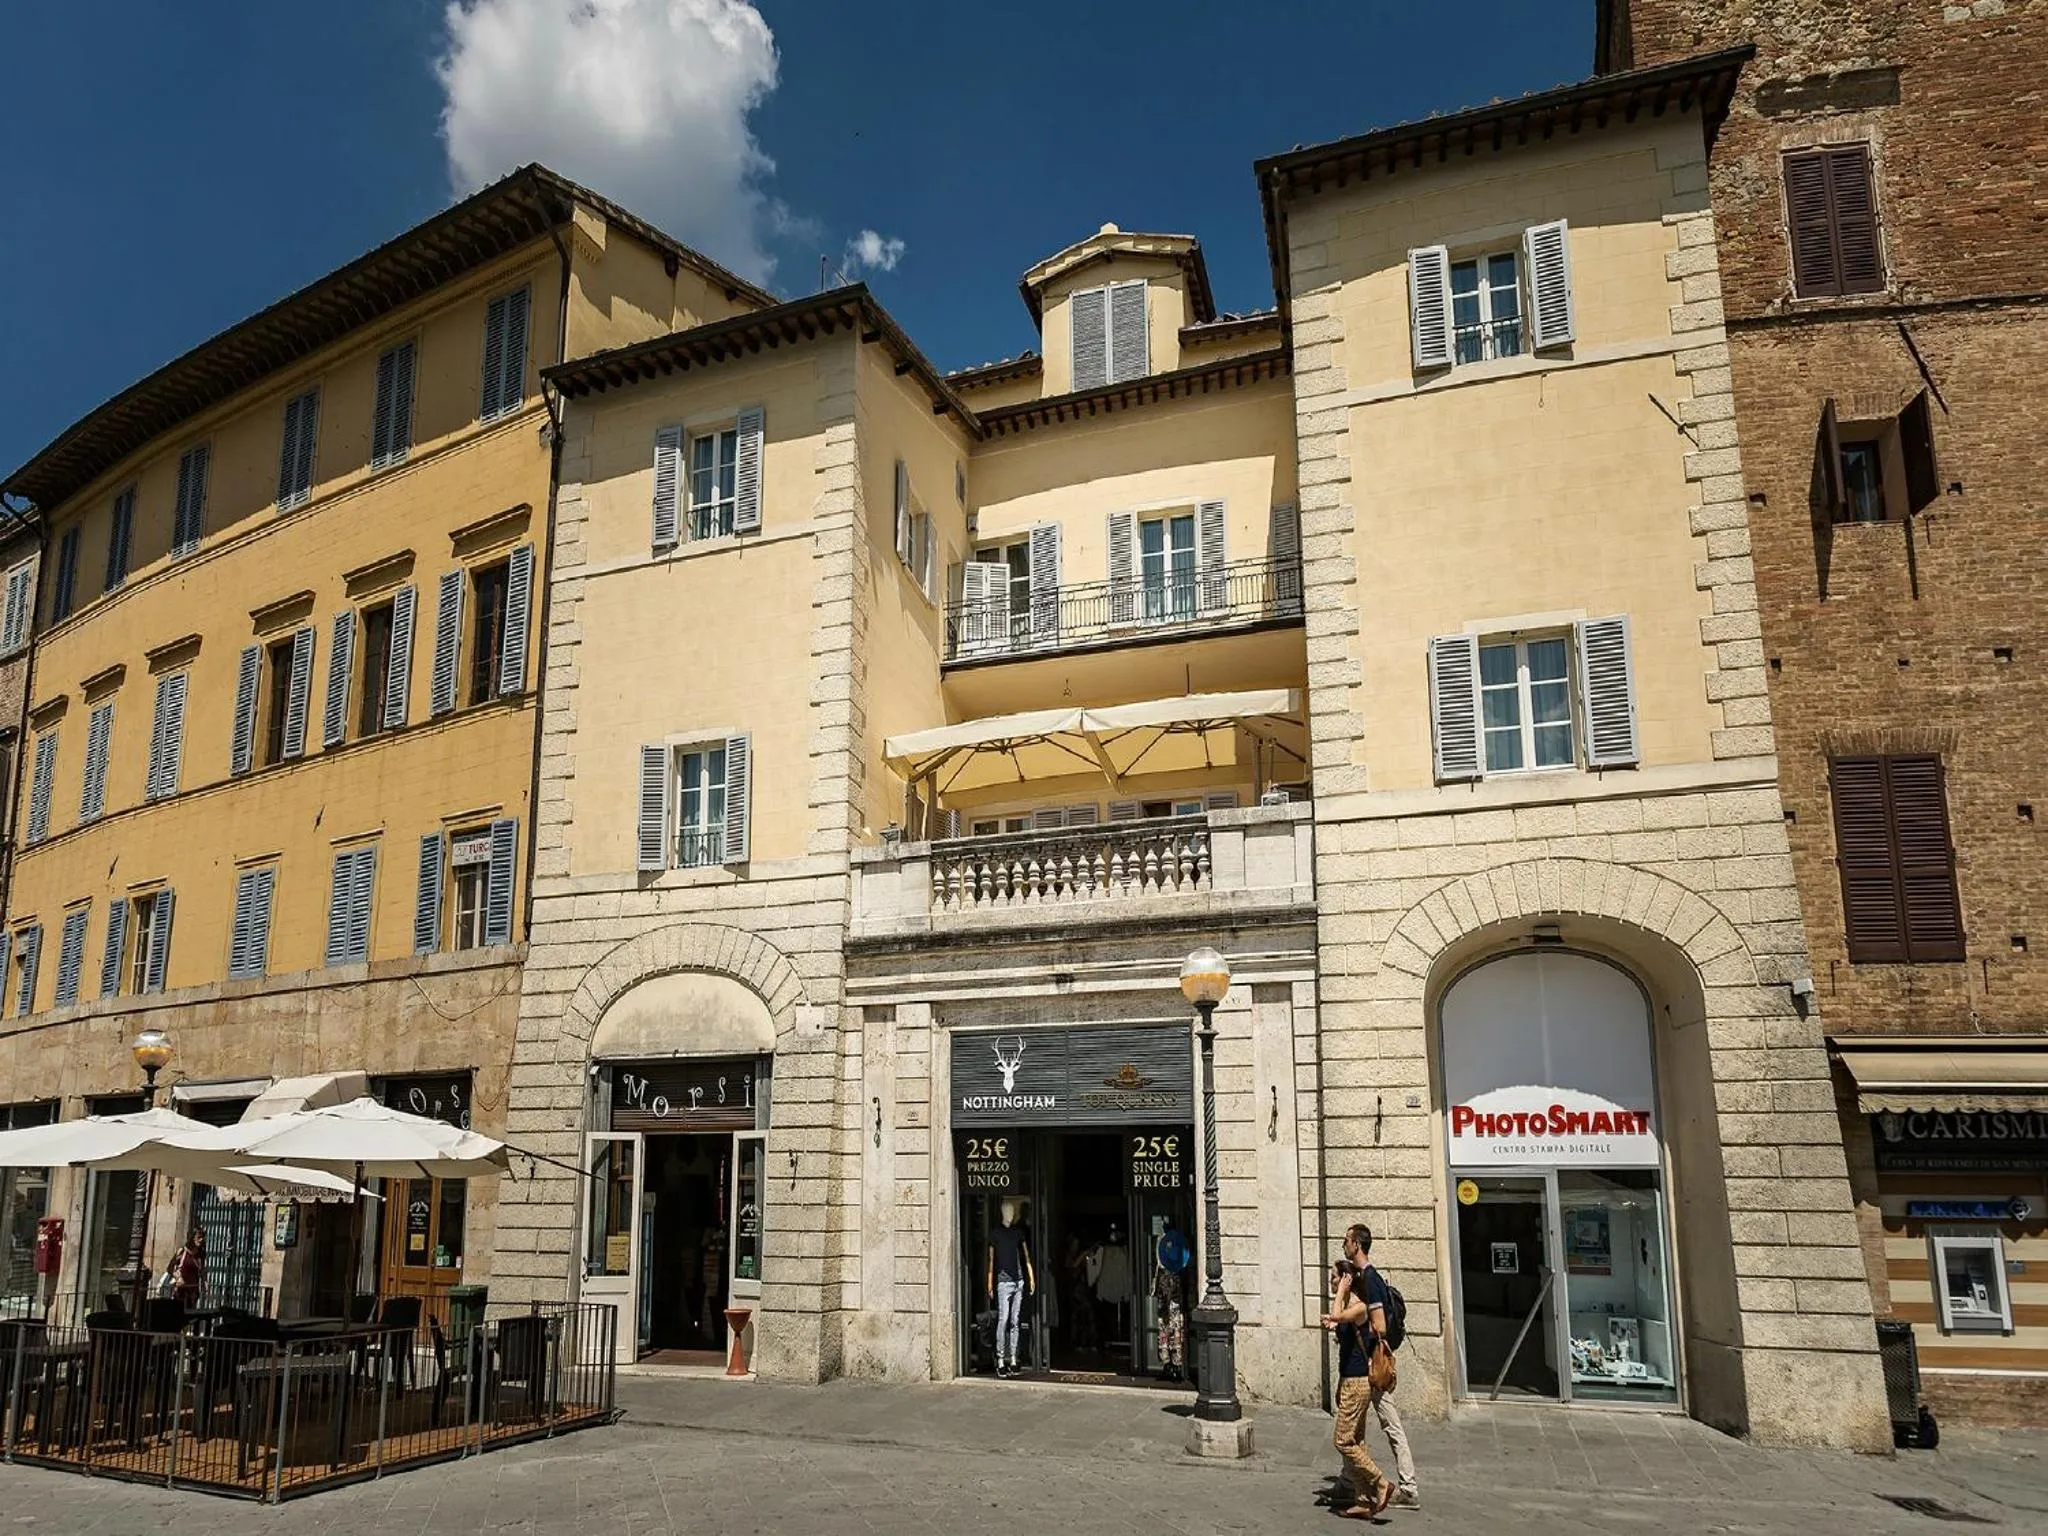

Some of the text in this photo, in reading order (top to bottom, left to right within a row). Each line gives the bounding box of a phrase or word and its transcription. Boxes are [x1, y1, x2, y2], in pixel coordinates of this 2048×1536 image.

[963, 1095, 1056, 1110] NOTTINGHAM
[966, 1137, 1009, 1159] 25€
[1132, 1135, 1180, 1158] 25€
[1493, 1143, 1612, 1154] CENTRO STAMPA DIGITALE
[967, 1161, 1010, 1173] PREZZO
[1133, 1161, 1180, 1173] SINGLE
[967, 1175, 1010, 1187] UNICO
[1133, 1174, 1181, 1188] PRICE
